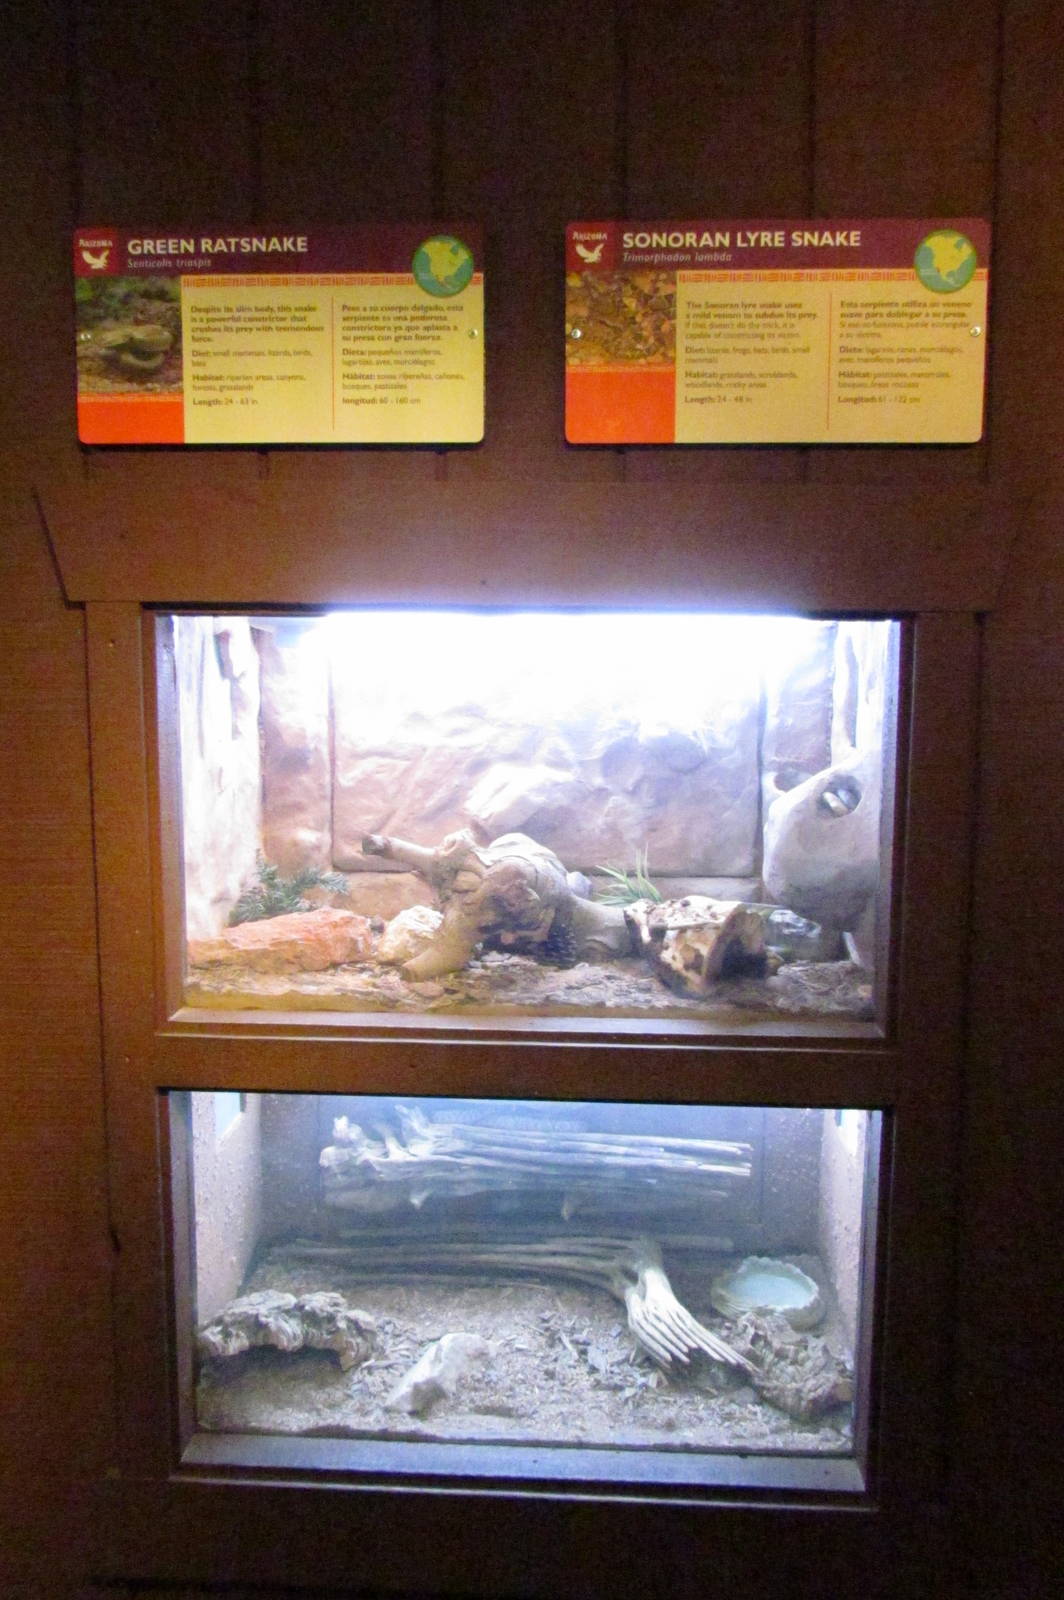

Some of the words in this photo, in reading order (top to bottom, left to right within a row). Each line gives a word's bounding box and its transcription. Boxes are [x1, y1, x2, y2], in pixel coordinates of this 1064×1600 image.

[127, 239, 195, 255] GREEN
[201, 236, 308, 253] RATSNAKE
[622, 232, 730, 249] SONORAN
[736, 231, 786, 247] LYRE
[791, 231, 861, 247] SNAKE
[695, 251, 732, 262] lambda
